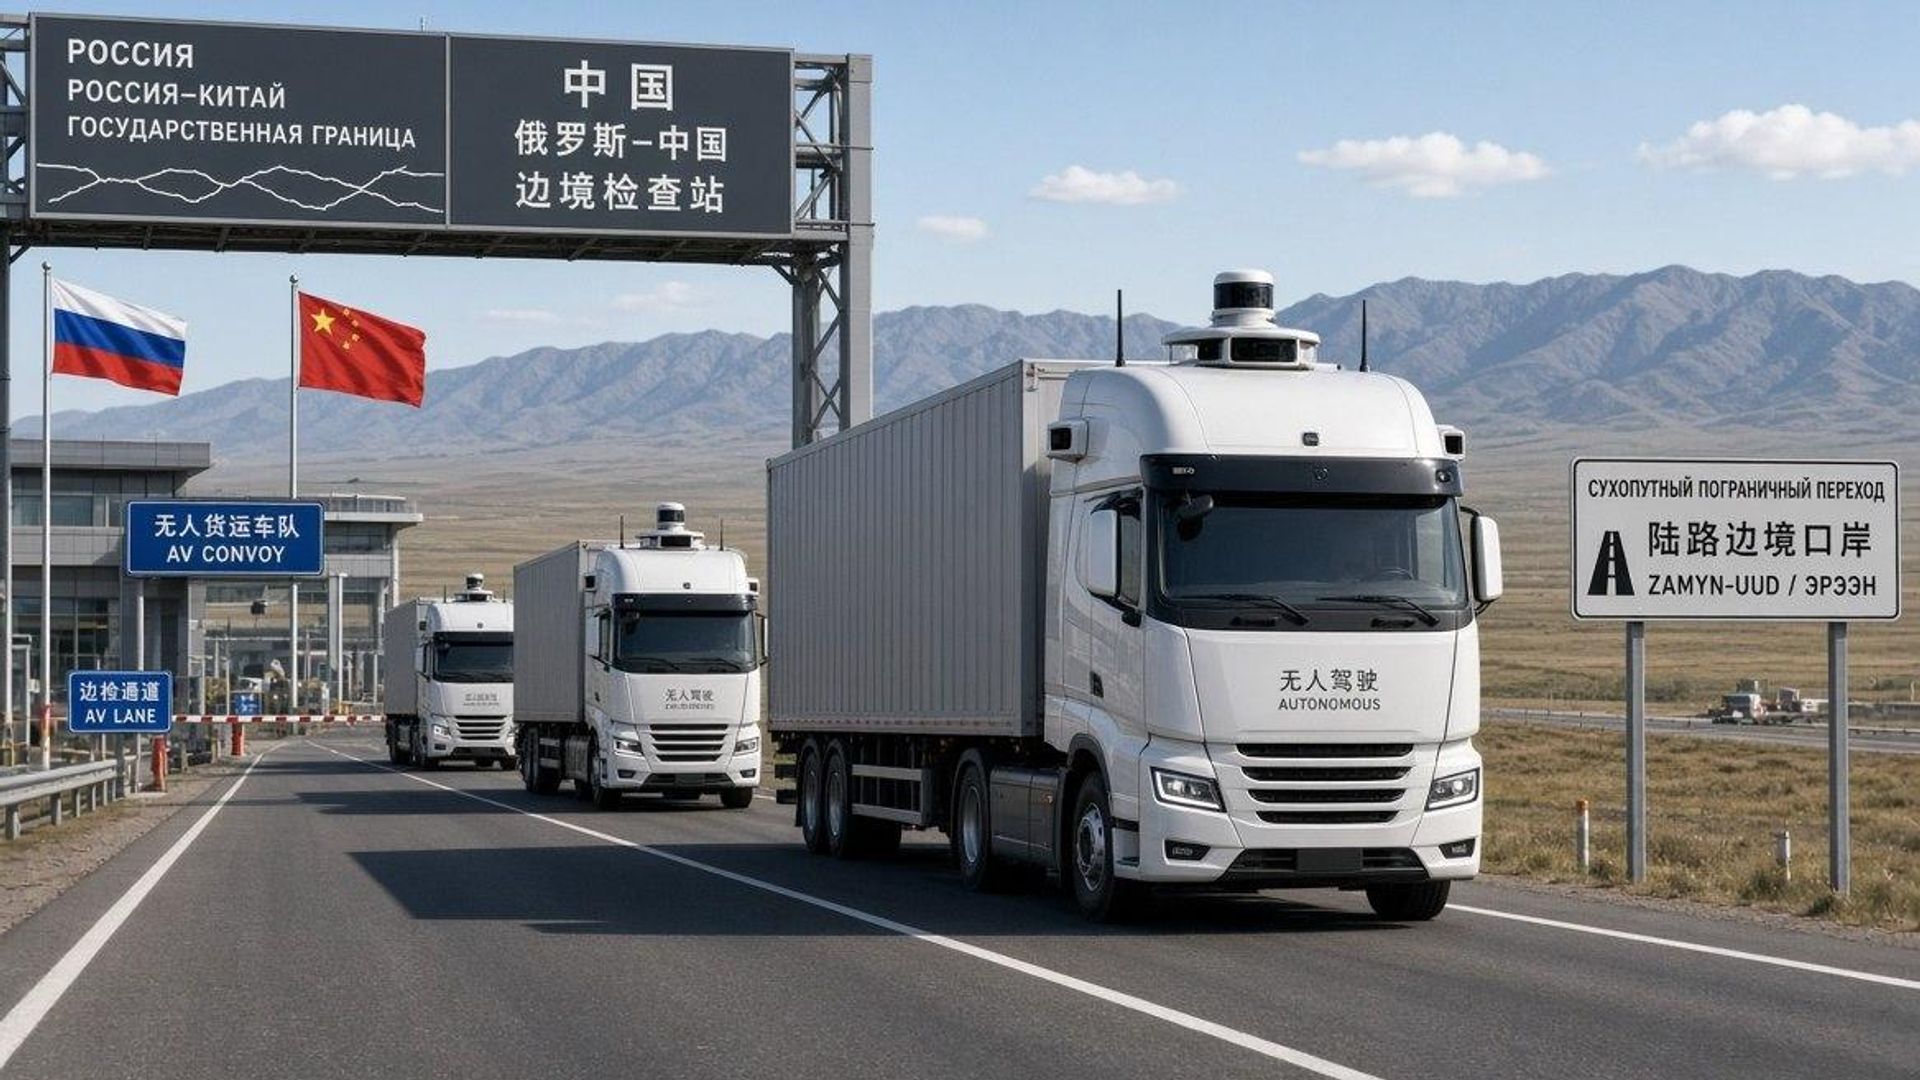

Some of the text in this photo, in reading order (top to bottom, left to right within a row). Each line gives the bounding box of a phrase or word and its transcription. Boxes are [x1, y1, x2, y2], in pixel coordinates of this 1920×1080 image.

[68, 38, 193, 69] РОССИЯ
[564, 59, 673, 111] 中国
[68, 115, 416, 152] ГОСУДАРСТВЕННАЯ ГРАНИЦА
[515, 170, 724, 213] 边境检查站
[1588, 475, 1885, 503] СУХОПУТНЫЙ ПОГРАНИЧНЫЙ ПЕРЕХОД
[154, 513, 300, 539] 无人货运车队
[1648, 520, 1872, 558] 陆路边境口岸
[166, 545, 285, 563] AV CONVOY
[1648, 574, 1780, 596] ZAMYN-UUD
[1805, 575, 1876, 596] ЭРЭЭН
[1280, 668, 1378, 692] 无人驾驶
[85, 708, 156, 724] AV LANE
[1279, 697, 1381, 711] AUTONOMOUS
